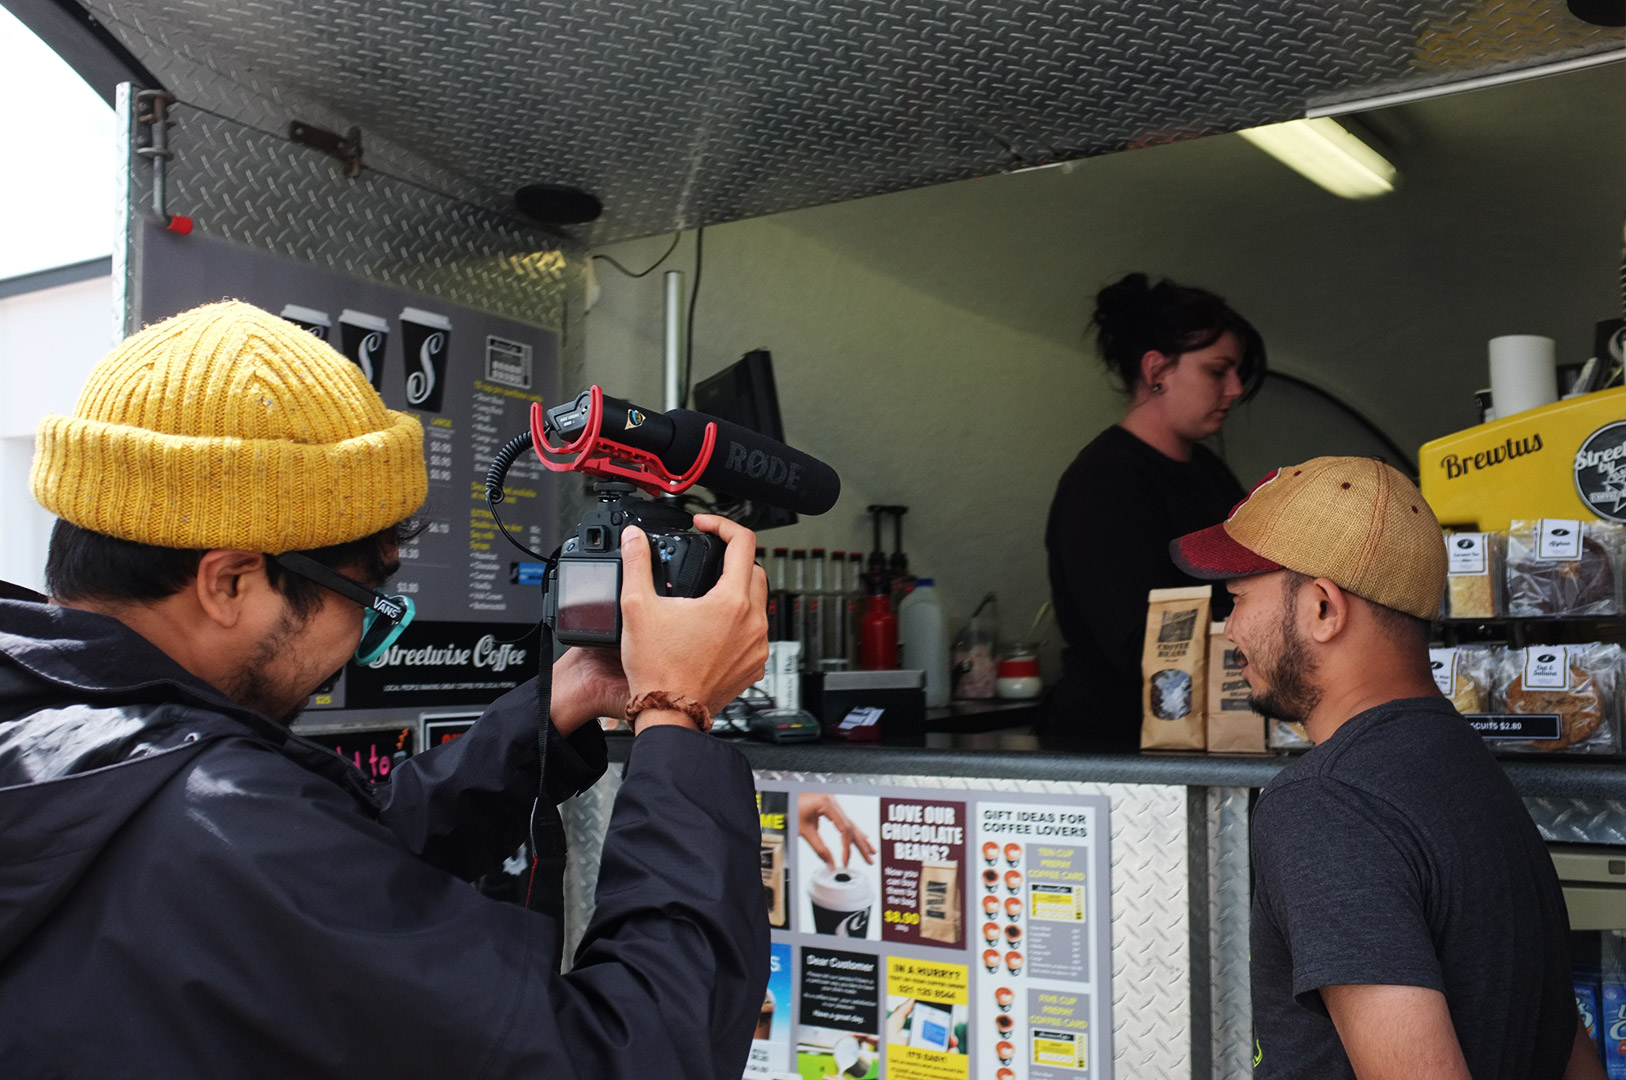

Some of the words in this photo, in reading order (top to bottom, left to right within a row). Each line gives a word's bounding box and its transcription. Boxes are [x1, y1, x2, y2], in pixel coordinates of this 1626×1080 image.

[1440, 432, 1544, 480] Brewtus
[724, 441, 801, 491] RØDE
[1597, 460, 1616, 474] by
[373, 596, 402, 619] VANS
[473, 634, 527, 672] Coffee
[1469, 721, 1498, 730] SCUITS
[1499, 721, 1522, 730] $2.80
[369, 744, 391, 777] to
[759, 813, 785, 830] ME
[888, 804, 923, 823] LOVE
[924, 805, 956, 826] OUR
[983, 810, 1013, 821] GIFT
[1017, 811, 1056, 823] IDEAS
[1060, 813, 1087, 825] FOR
[881, 822, 964, 845] CHOCOLATE
[983, 822, 1032, 834] COFFEE
[1036, 825, 1088, 837] LOVERS
[893, 842, 949, 862] BEANS?
[1038, 847, 1055, 857] TEN
[1056, 848, 1075, 858] CUP
[884, 867, 904, 877] Now
[904, 870, 919, 879] you
[1027, 869, 1060, 879] COFFEE
[1061, 871, 1086, 881] CARD
[887, 895, 901, 905] the
[901, 896, 917, 908] bag
[806, 954, 829, 967] Dear
[829, 957, 875, 972] Customer
[917, 966, 961, 980] HURRY?
[1038, 994, 1058, 1004] FIVE
[1059, 996, 1078, 1005] CUP
[1028, 1015, 1062, 1026] COFFEE
[1063, 1018, 1088, 1029] CARD
